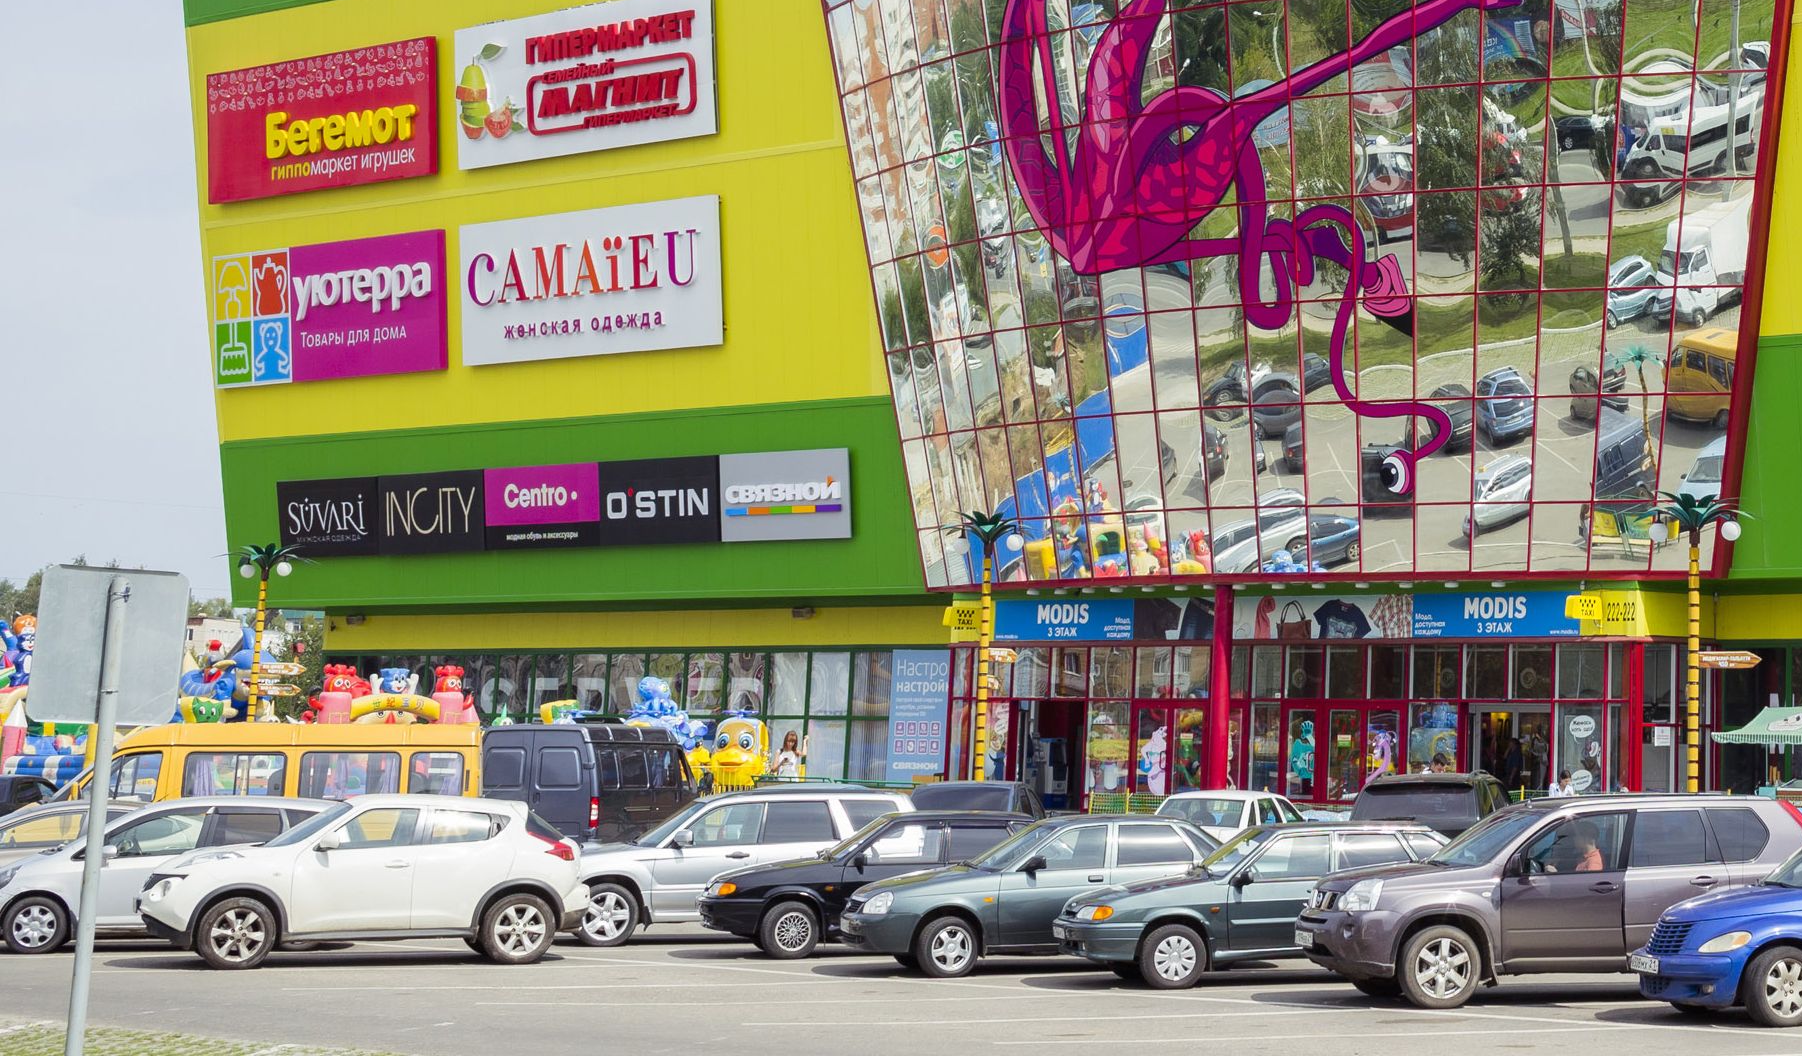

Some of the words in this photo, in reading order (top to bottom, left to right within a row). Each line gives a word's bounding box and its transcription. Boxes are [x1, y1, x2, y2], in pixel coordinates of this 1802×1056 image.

[525, 9, 696, 65] ГИПЕРМАРКЕТ
[541, 57, 615, 83] СЕМЕЙНЫЙ
[537, 68, 684, 118] МАГНИТ
[583, 103, 681, 129] ГИПЕРМАРКЕТ
[265, 104, 418, 160] Бегемот
[271, 155, 358, 182] гиппомаркет
[361, 146, 416, 172] игрушек
[292, 261, 432, 321] уютерра
[504, 315, 582, 340] женская
[590, 309, 665, 332] одежда
[503, 482, 567, 508] Centro
[385, 486, 476, 537] INCITY
[1036, 603, 1090, 625] MODIS
[1463, 596, 1528, 620] MODIS
[1580, 608, 1596, 617] TAXI
[958, 618, 973, 626] TAXI
[1047, 627, 1052, 637] 3
[1054, 627, 1077, 637] ЭТАЖ
[1477, 622, 1483, 633] 3
[1485, 622, 1513, 633] ЭТАЖ
